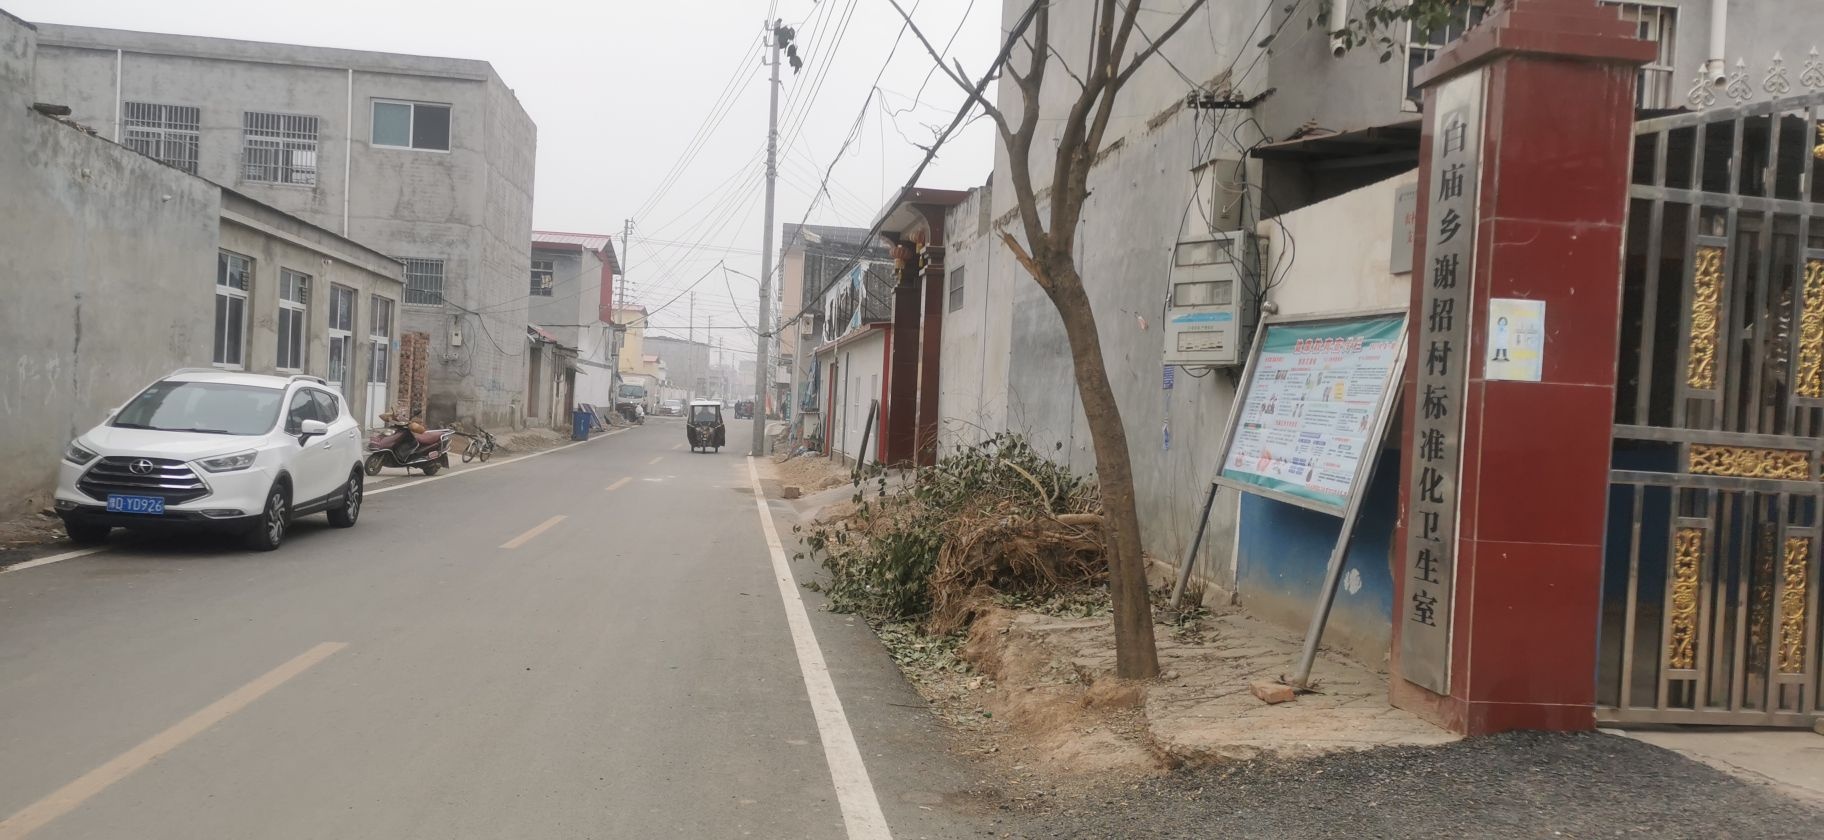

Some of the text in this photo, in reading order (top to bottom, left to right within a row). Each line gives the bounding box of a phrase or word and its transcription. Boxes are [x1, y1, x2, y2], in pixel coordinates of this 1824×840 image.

[1410, 115, 1467, 627] 白庙乡谢招村标准化卫生室
